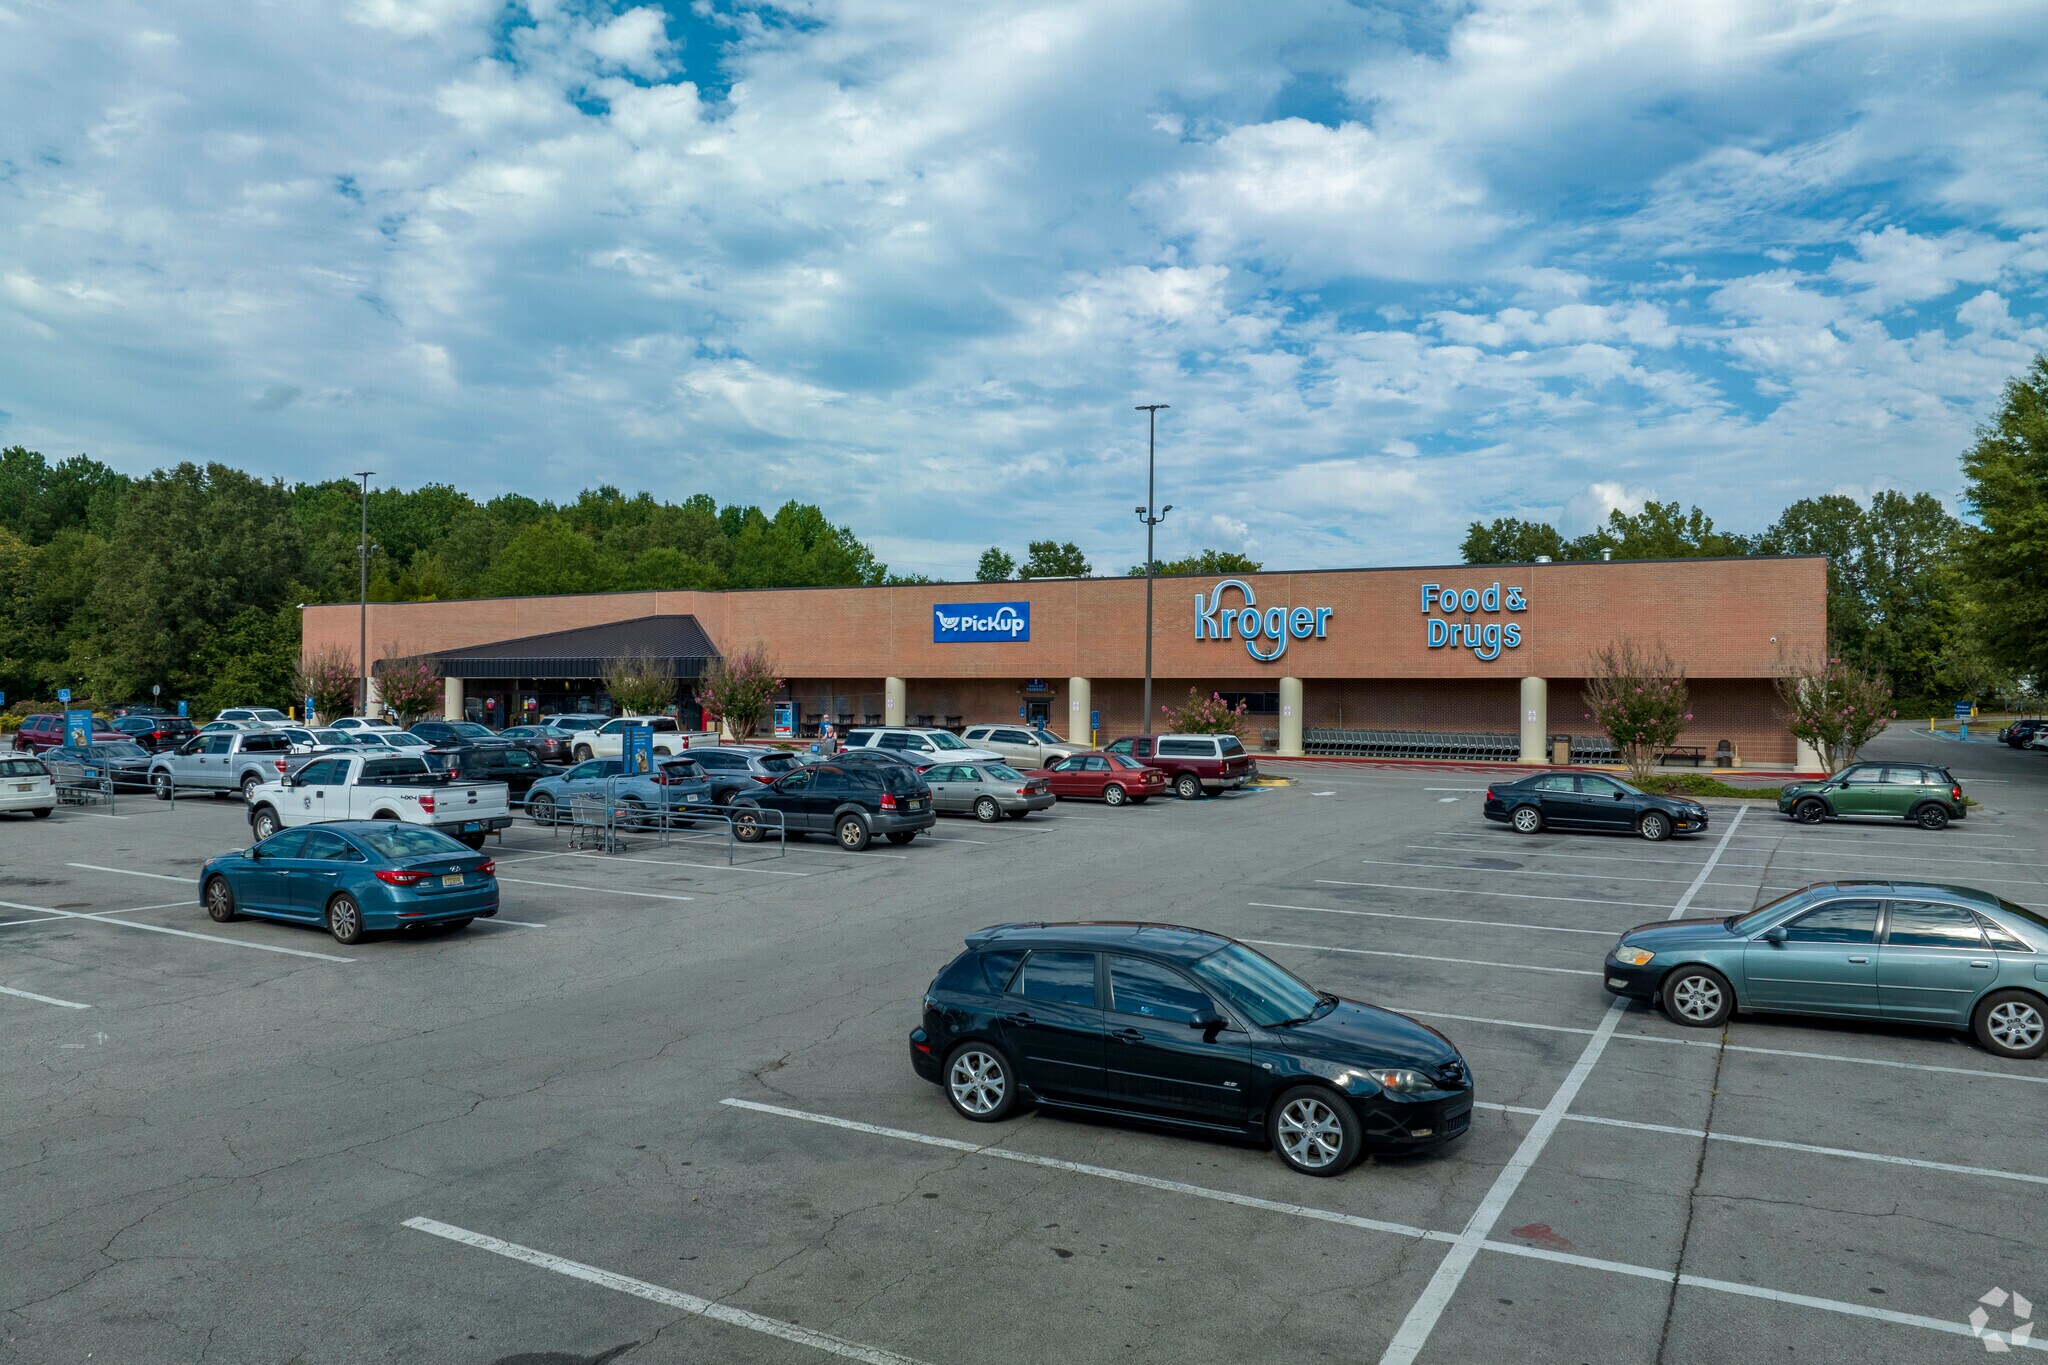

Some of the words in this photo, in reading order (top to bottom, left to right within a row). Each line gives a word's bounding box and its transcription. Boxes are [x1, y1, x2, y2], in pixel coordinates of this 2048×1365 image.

[1421, 582, 1500, 613] Food
[1505, 587, 1527, 611] &
[1195, 579, 1332, 661] Kroger
[1427, 618, 1521, 660] Drugs
